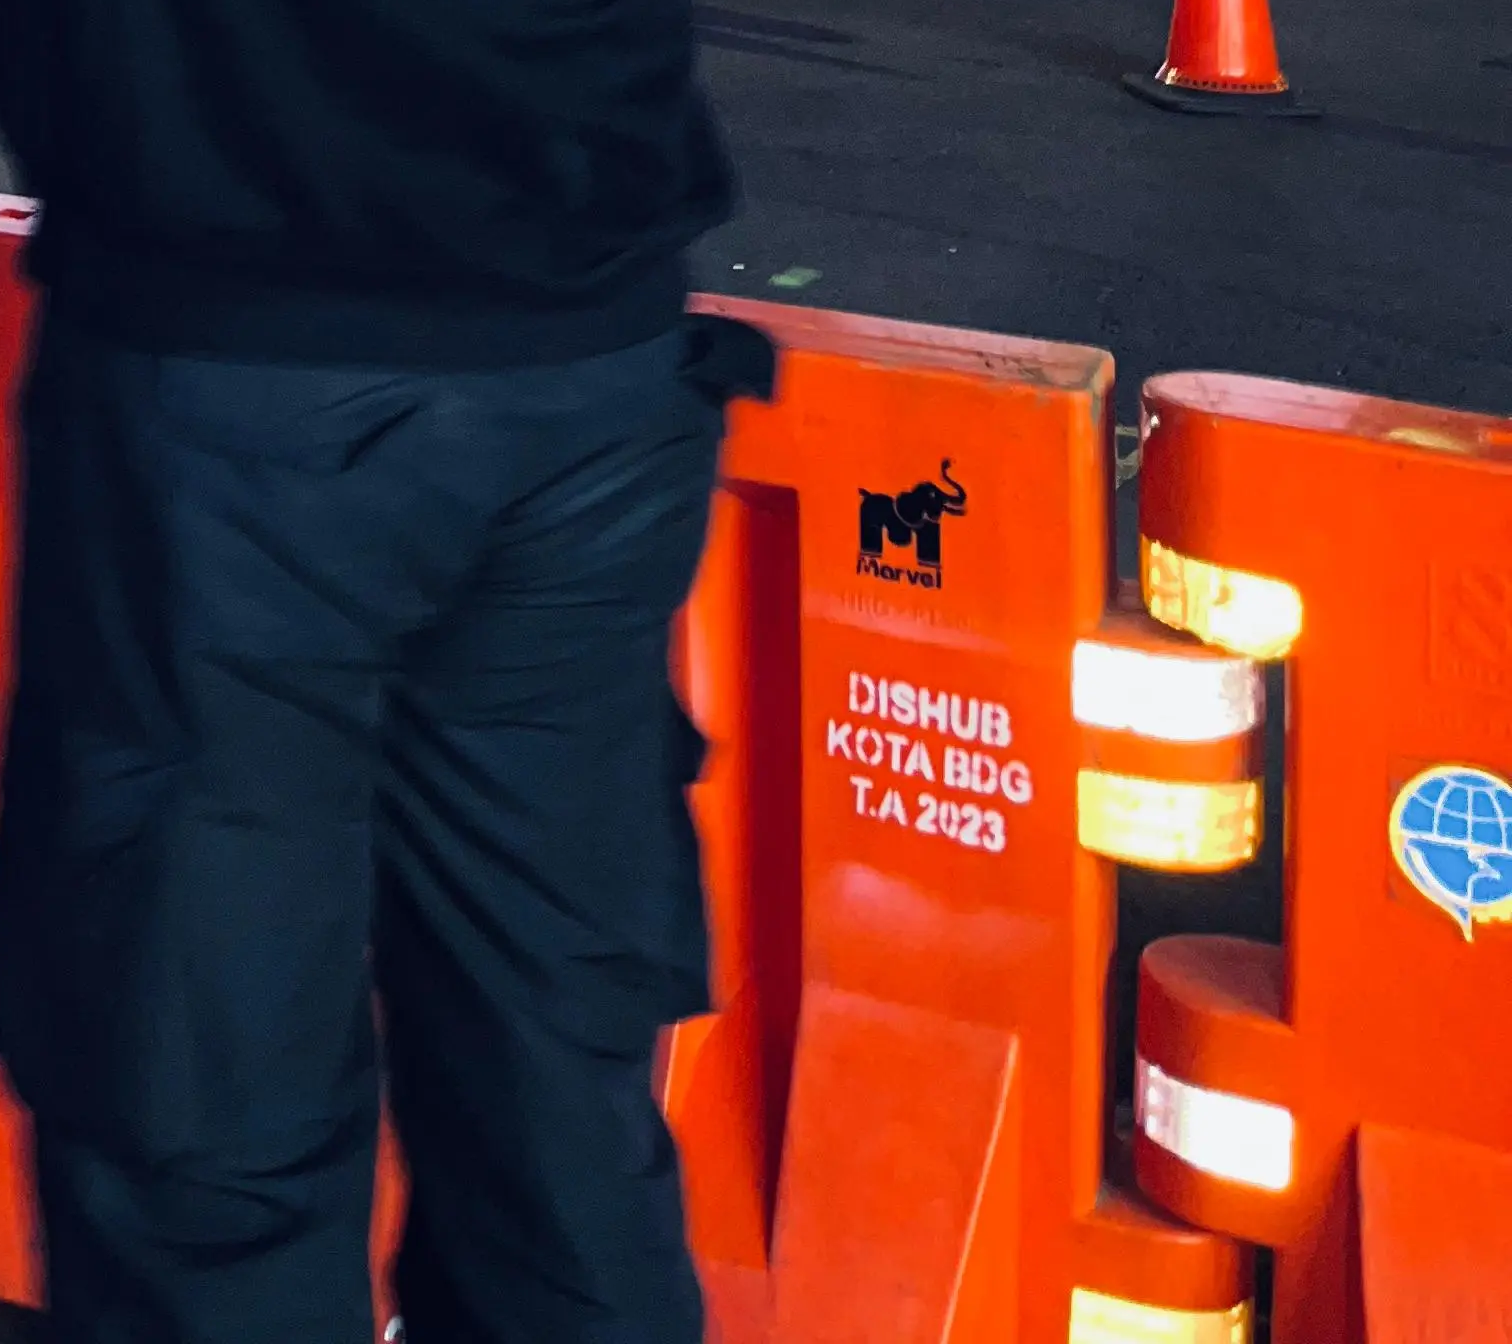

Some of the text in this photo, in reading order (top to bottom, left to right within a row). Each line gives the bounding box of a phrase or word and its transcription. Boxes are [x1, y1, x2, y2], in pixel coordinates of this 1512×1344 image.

[856, 557, 942, 590] Marvel
[848, 670, 1013, 748] DISHUB
[826, 717, 1033, 805] KOTA BDG
[849, 774, 1007, 853] T.A 2023
